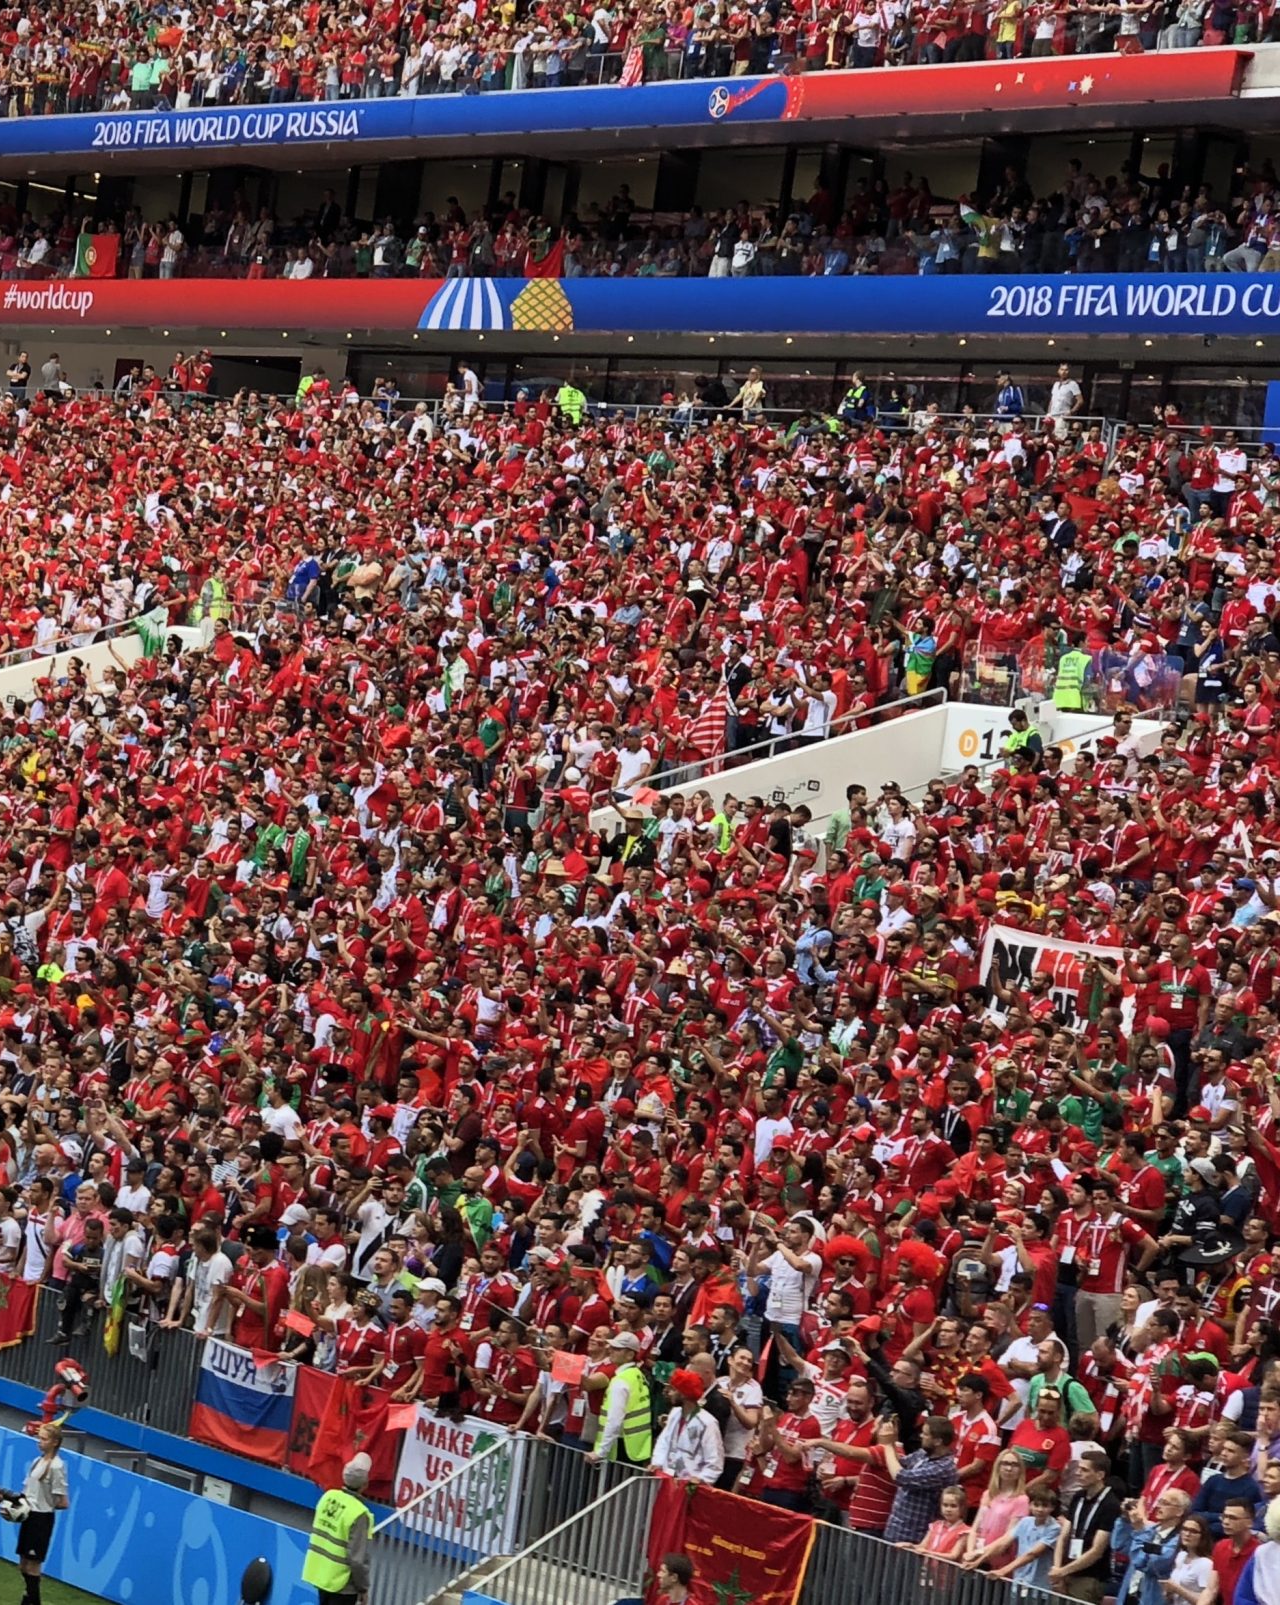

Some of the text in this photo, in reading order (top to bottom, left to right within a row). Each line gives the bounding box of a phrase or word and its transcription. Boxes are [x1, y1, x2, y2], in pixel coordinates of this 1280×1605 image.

[92, 109, 359, 146] 2018 FIFA WORLD CUP RUSSIA
[3, 283, 93, 317] #worldcup
[987, 284, 1280, 317] 2018 FIFA WORLD CU
[211, 1343, 257, 1386] ШУЯ
[415, 1417, 474, 1459] MAKE
[425, 1454, 454, 1482] US
